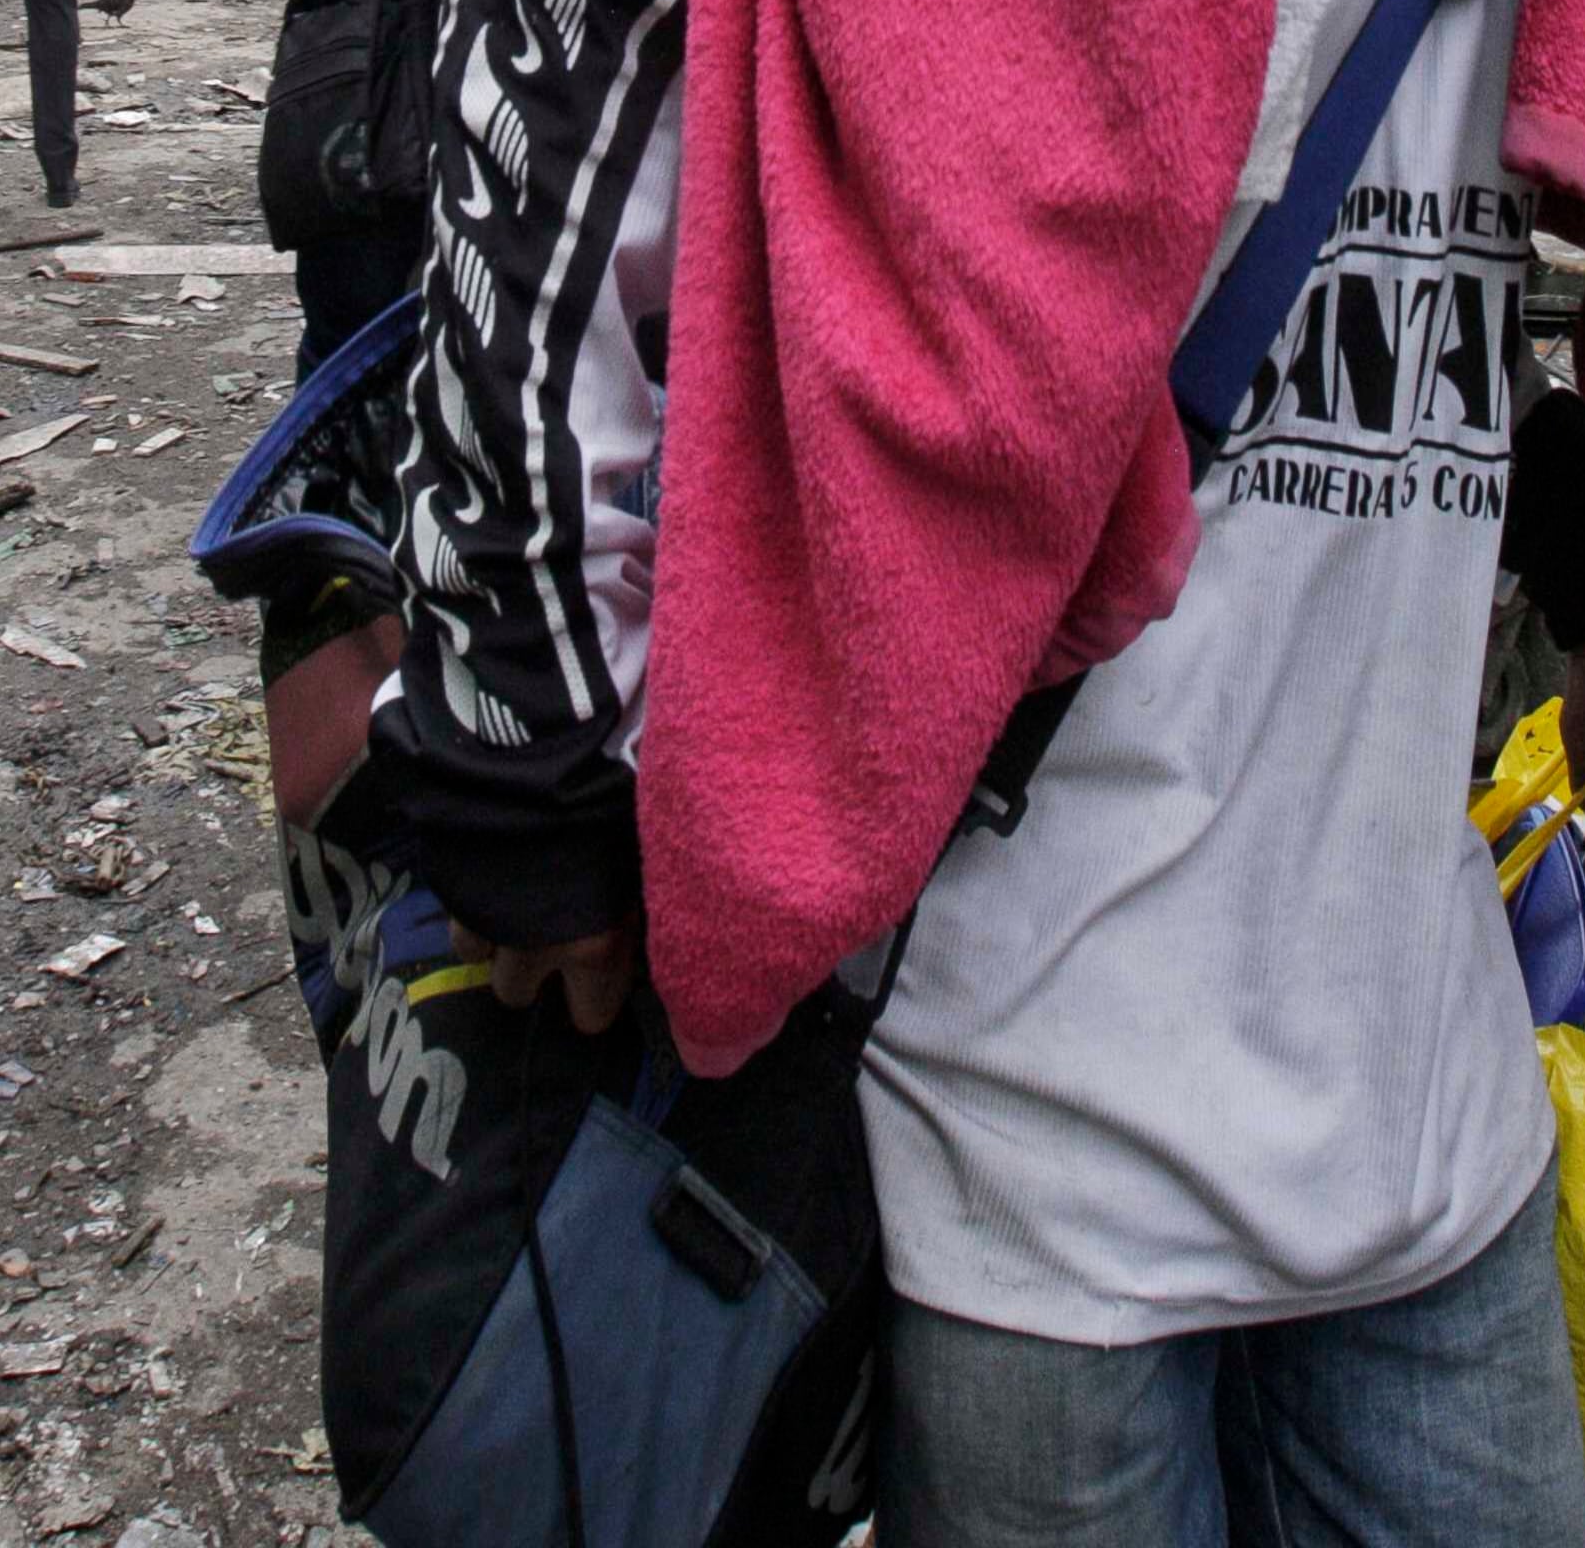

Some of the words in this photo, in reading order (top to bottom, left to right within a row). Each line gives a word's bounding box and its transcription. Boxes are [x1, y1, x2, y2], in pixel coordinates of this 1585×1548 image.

[1228, 458, 1395, 519] CARRERA
[1400, 460, 1419, 510] 5
[1432, 464, 1505, 520] CON
